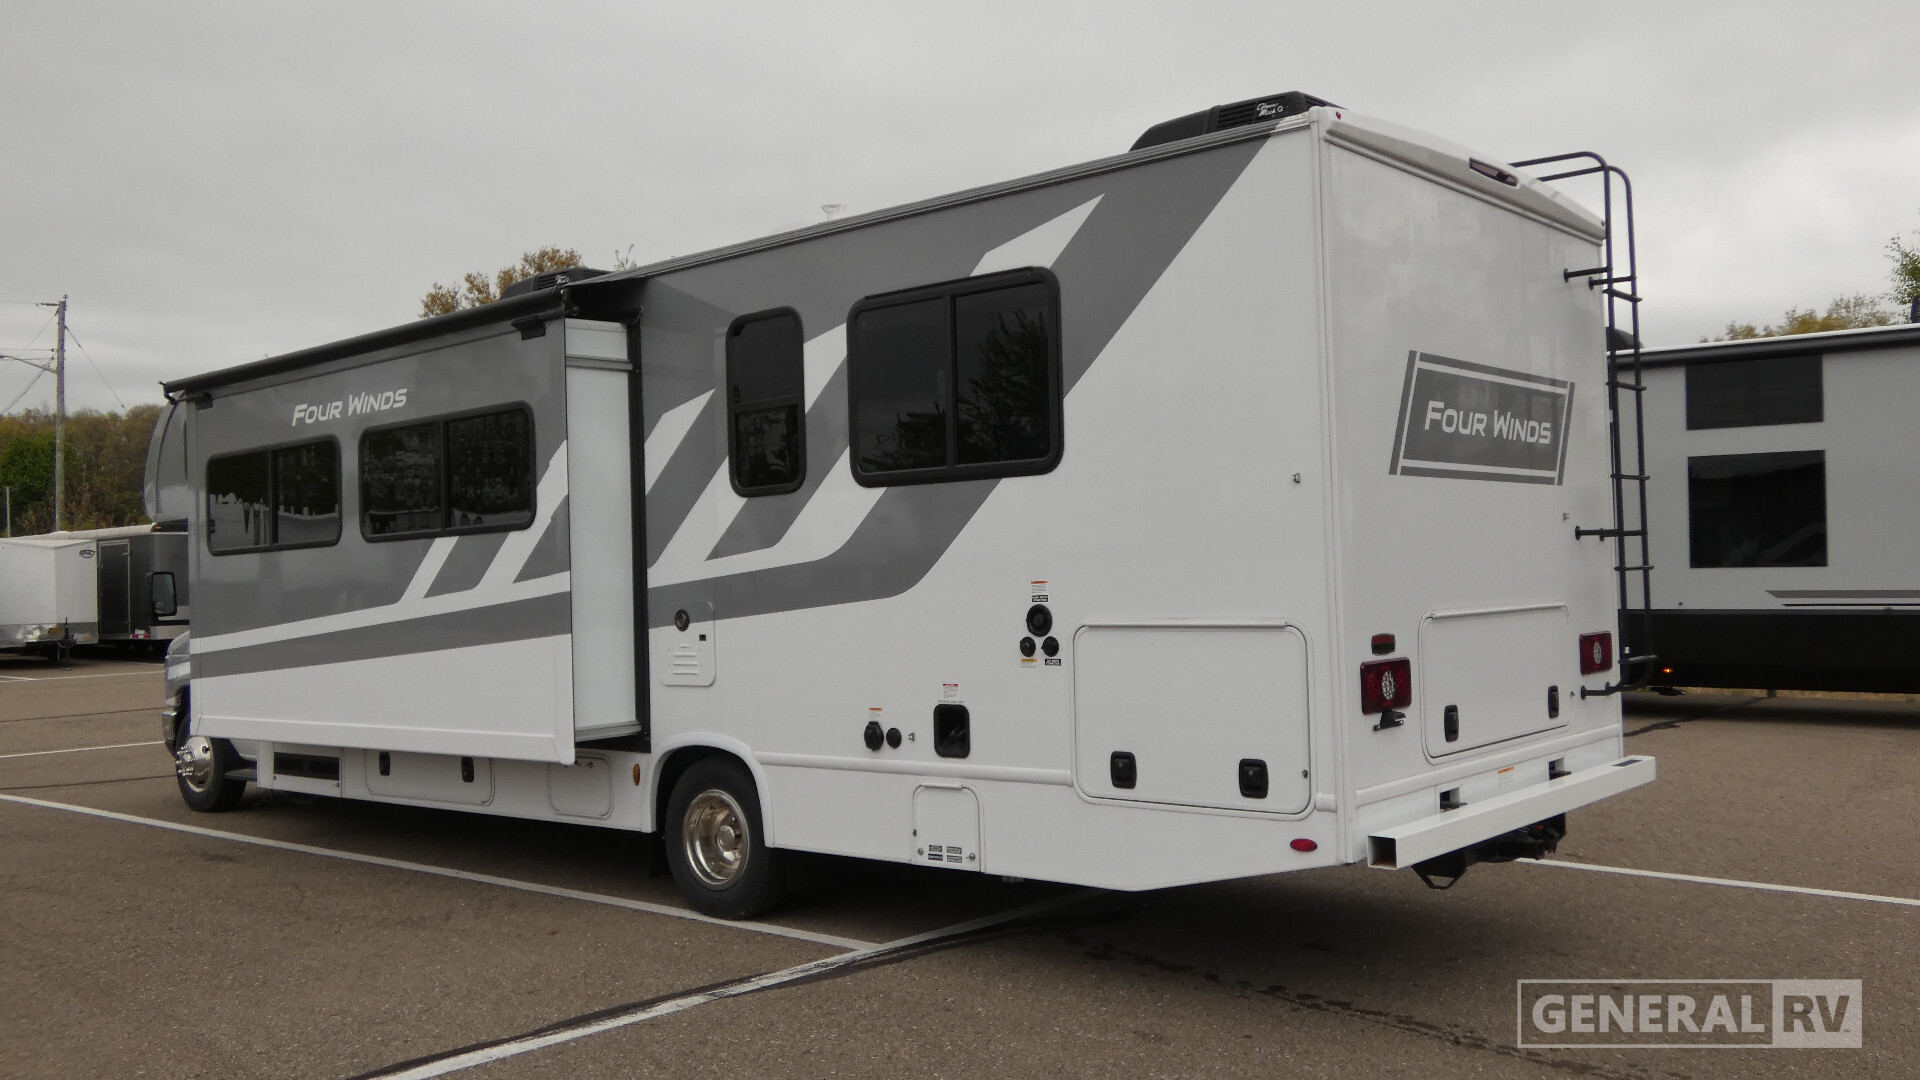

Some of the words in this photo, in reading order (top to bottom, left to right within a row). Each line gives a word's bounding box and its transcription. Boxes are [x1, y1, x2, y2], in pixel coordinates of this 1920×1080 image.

[291, 400, 343, 427] FOUR
[347, 388, 408, 417] WINDS
[1424, 400, 1488, 437] FOUR
[1493, 409, 1552, 445] WINDS
